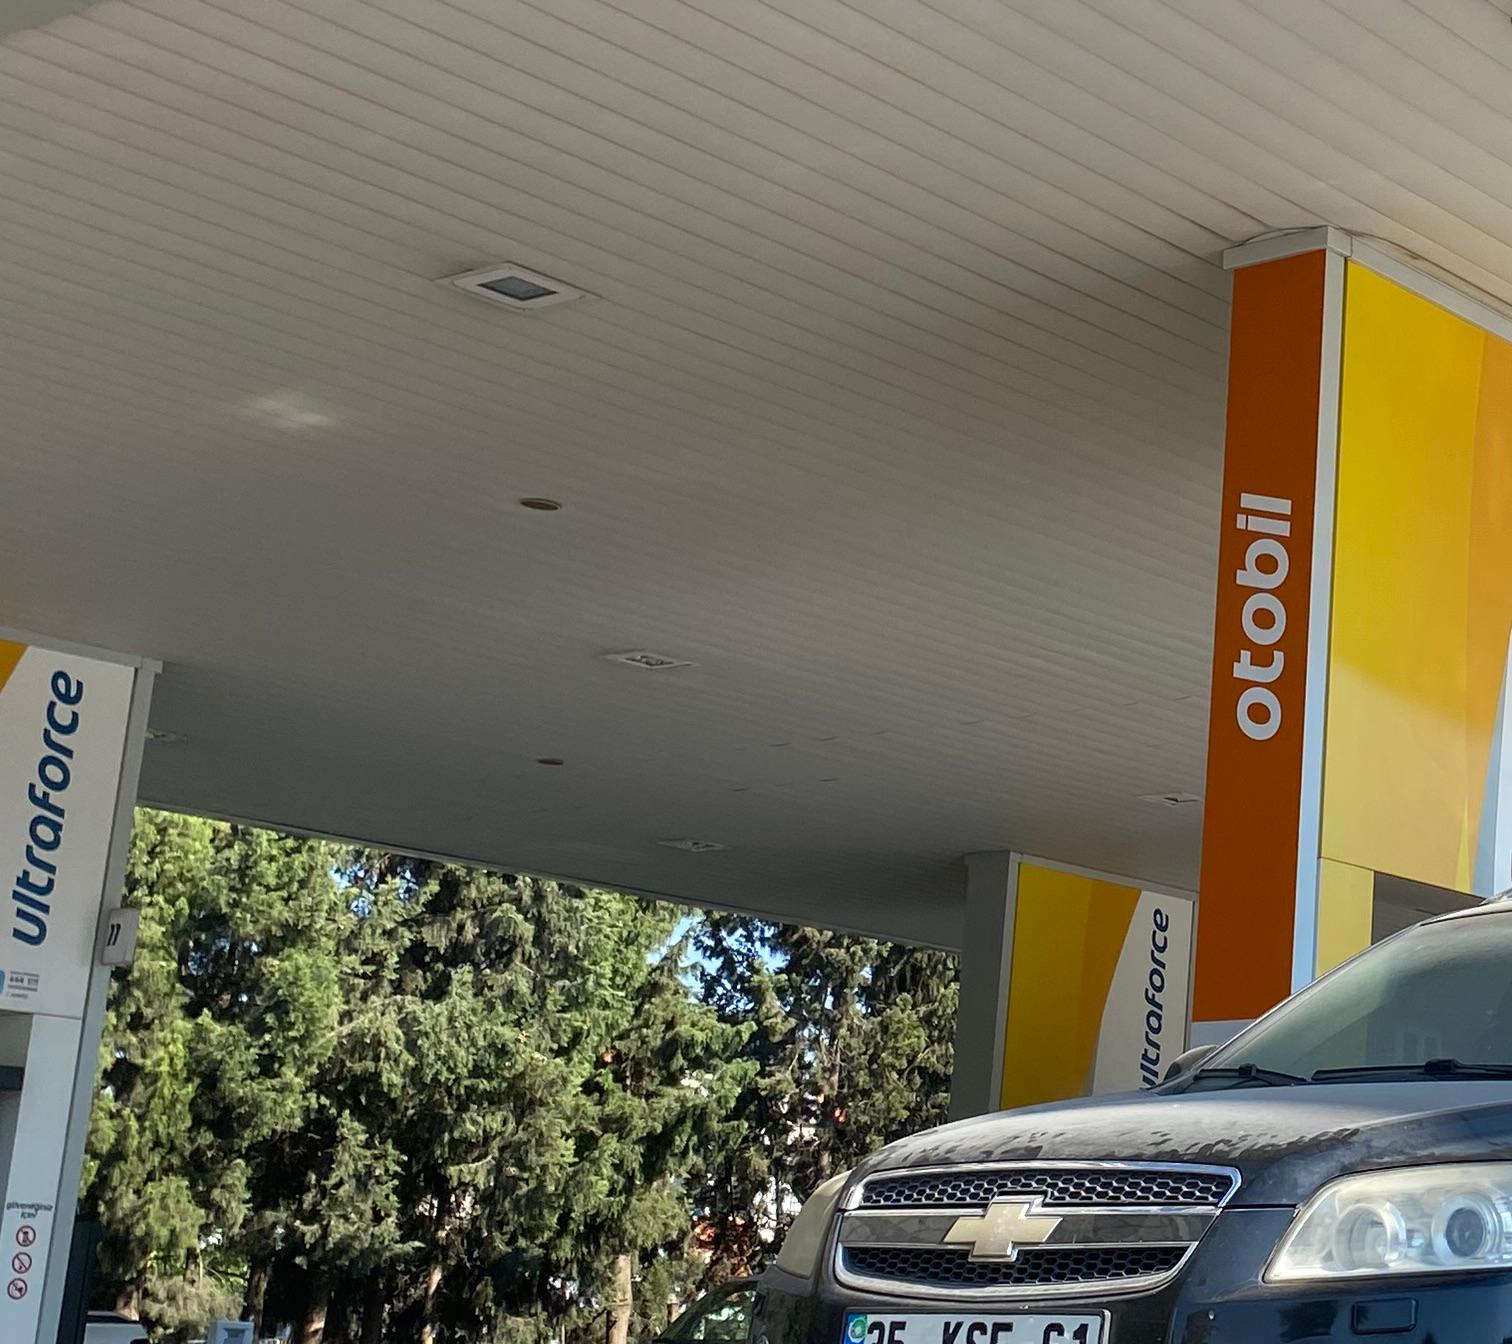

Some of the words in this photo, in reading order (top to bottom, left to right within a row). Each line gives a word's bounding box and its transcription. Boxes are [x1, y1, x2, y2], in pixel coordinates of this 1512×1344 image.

[1232, 492, 1293, 742] otobil
[12, 669, 84, 947] ultraforce
[107, 922, 122, 947] 11
